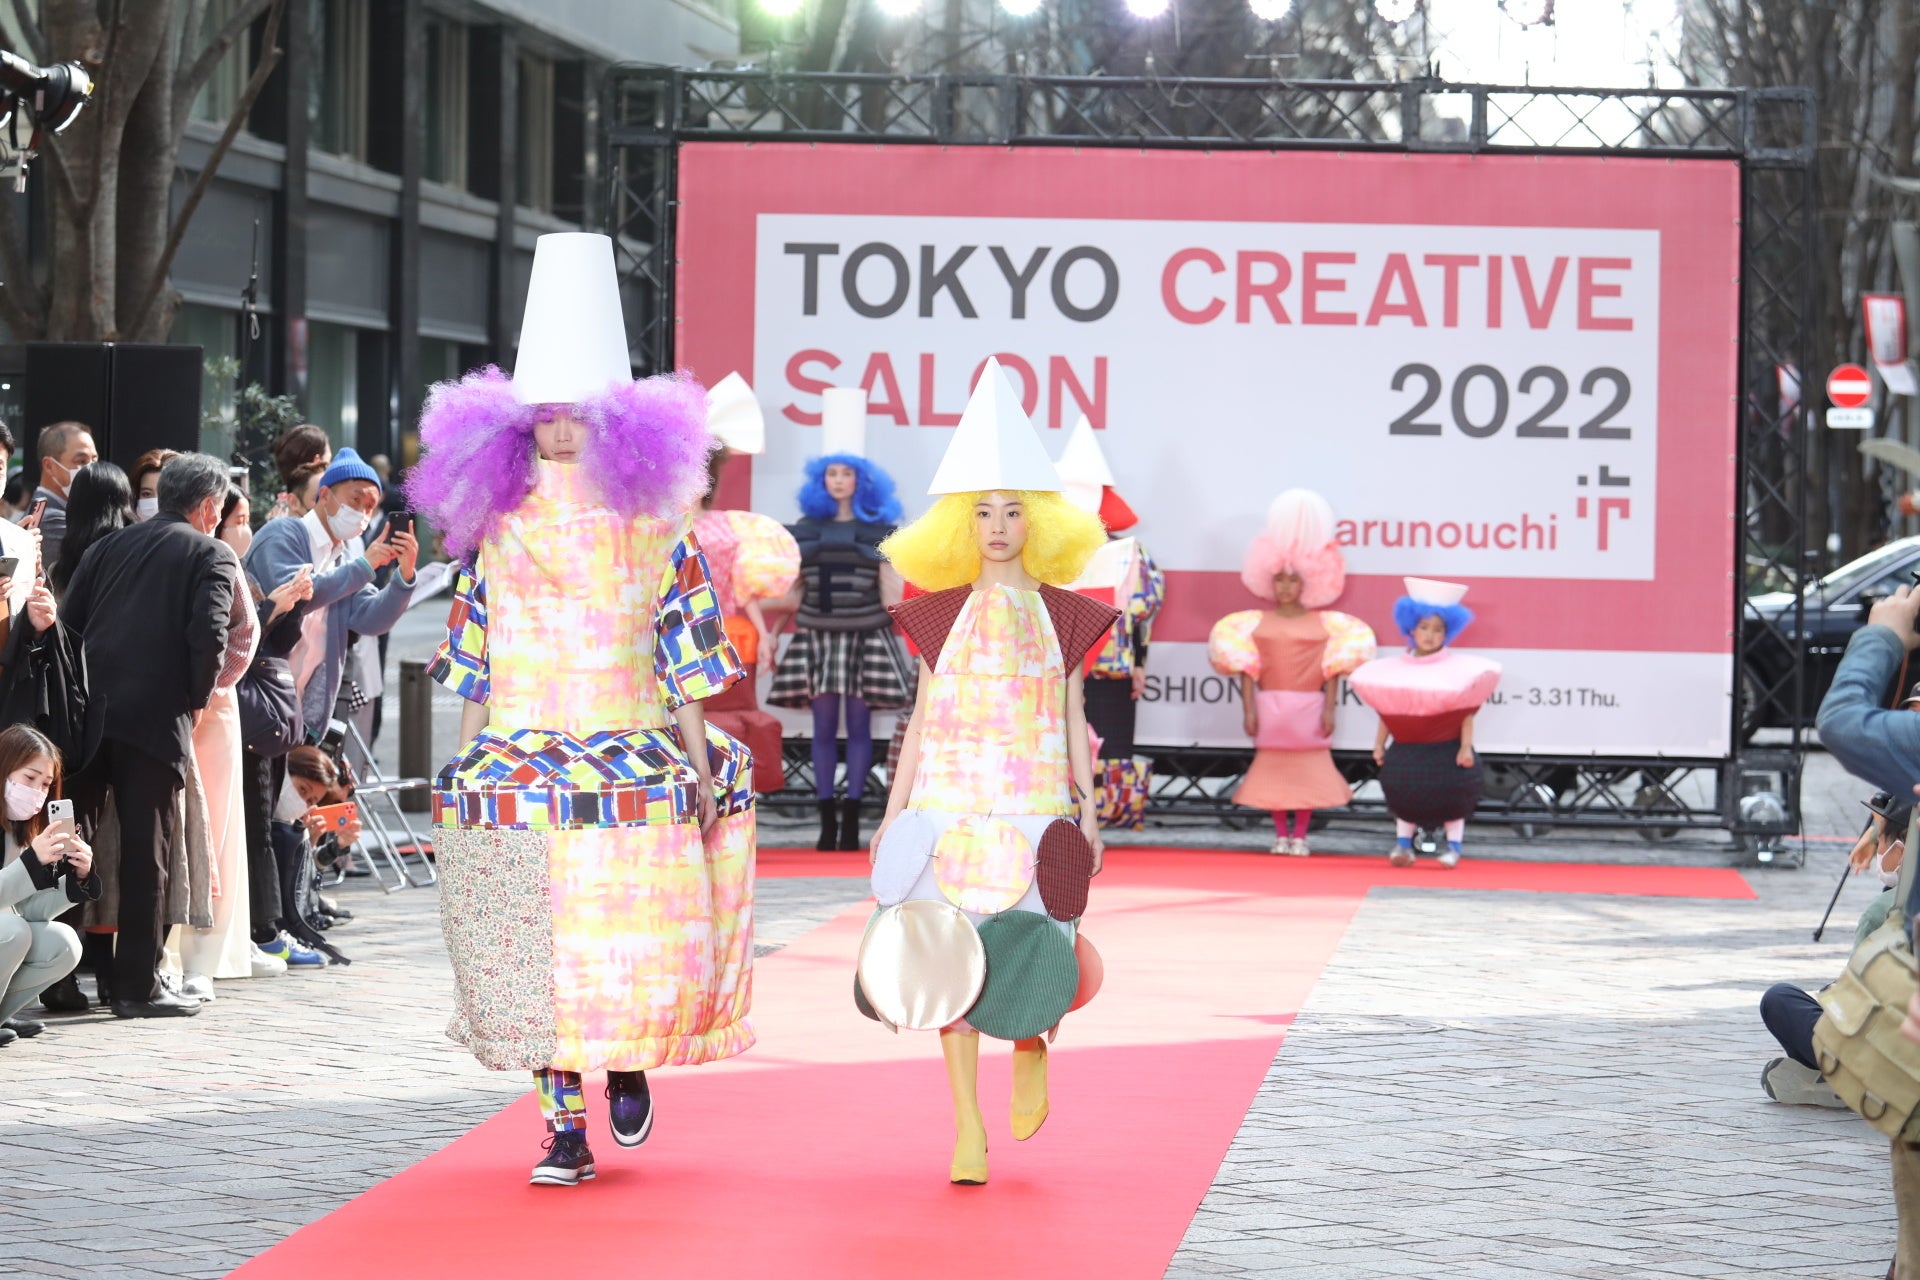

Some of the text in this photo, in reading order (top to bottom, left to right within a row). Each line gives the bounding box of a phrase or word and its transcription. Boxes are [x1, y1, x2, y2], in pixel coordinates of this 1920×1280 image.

[784, 242, 1633, 331] TOKYO CREATIVE
[783, 349, 1631, 439] SALON 2022
[1335, 513, 1557, 550] arunouchi
[1143, 675, 1244, 703] SHION
